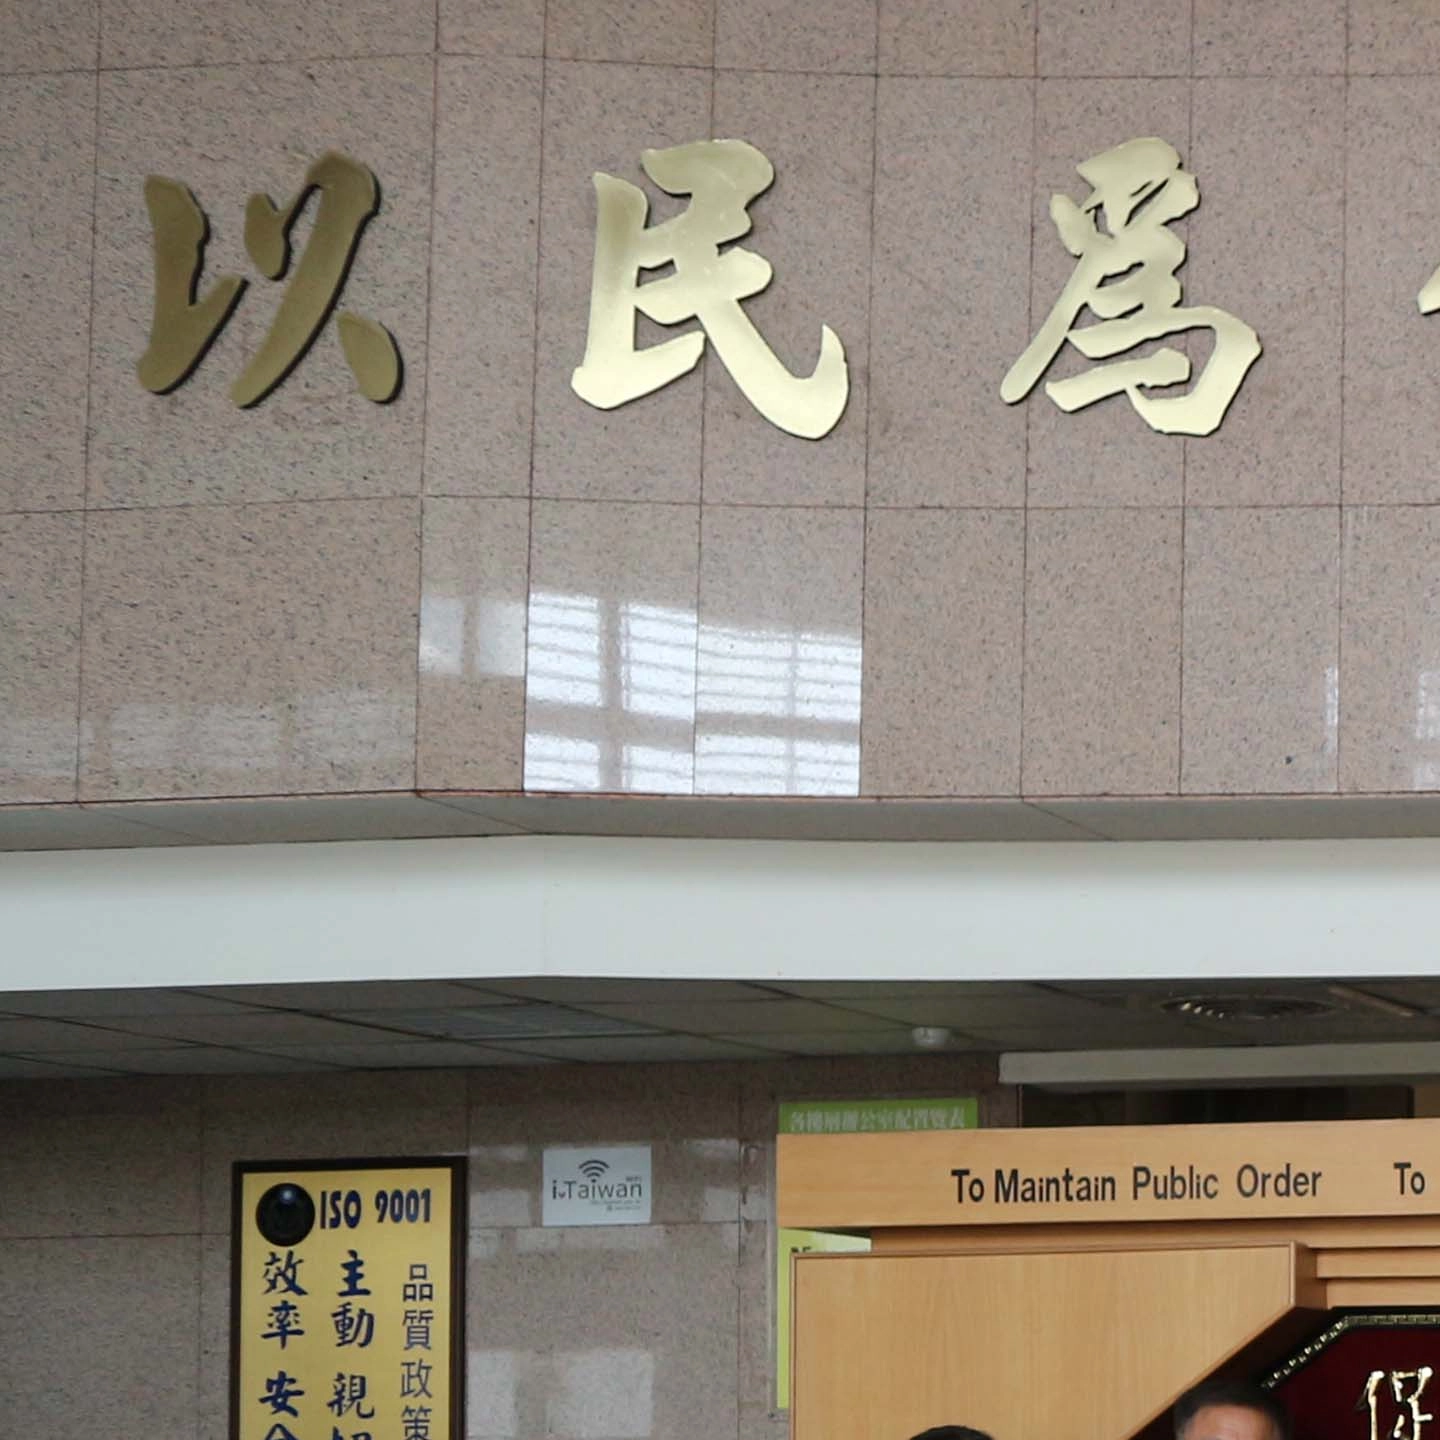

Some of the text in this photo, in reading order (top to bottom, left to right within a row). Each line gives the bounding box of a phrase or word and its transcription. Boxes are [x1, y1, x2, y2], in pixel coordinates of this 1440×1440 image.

[951, 1163, 1321, 1203] To Maintain Public Order
[1394, 1163, 1425, 1195] To
[320, 1188, 431, 1230] ISO 9001
[262, 1250, 308, 1351] 效率
[331, 1250, 374, 1347] 主動
